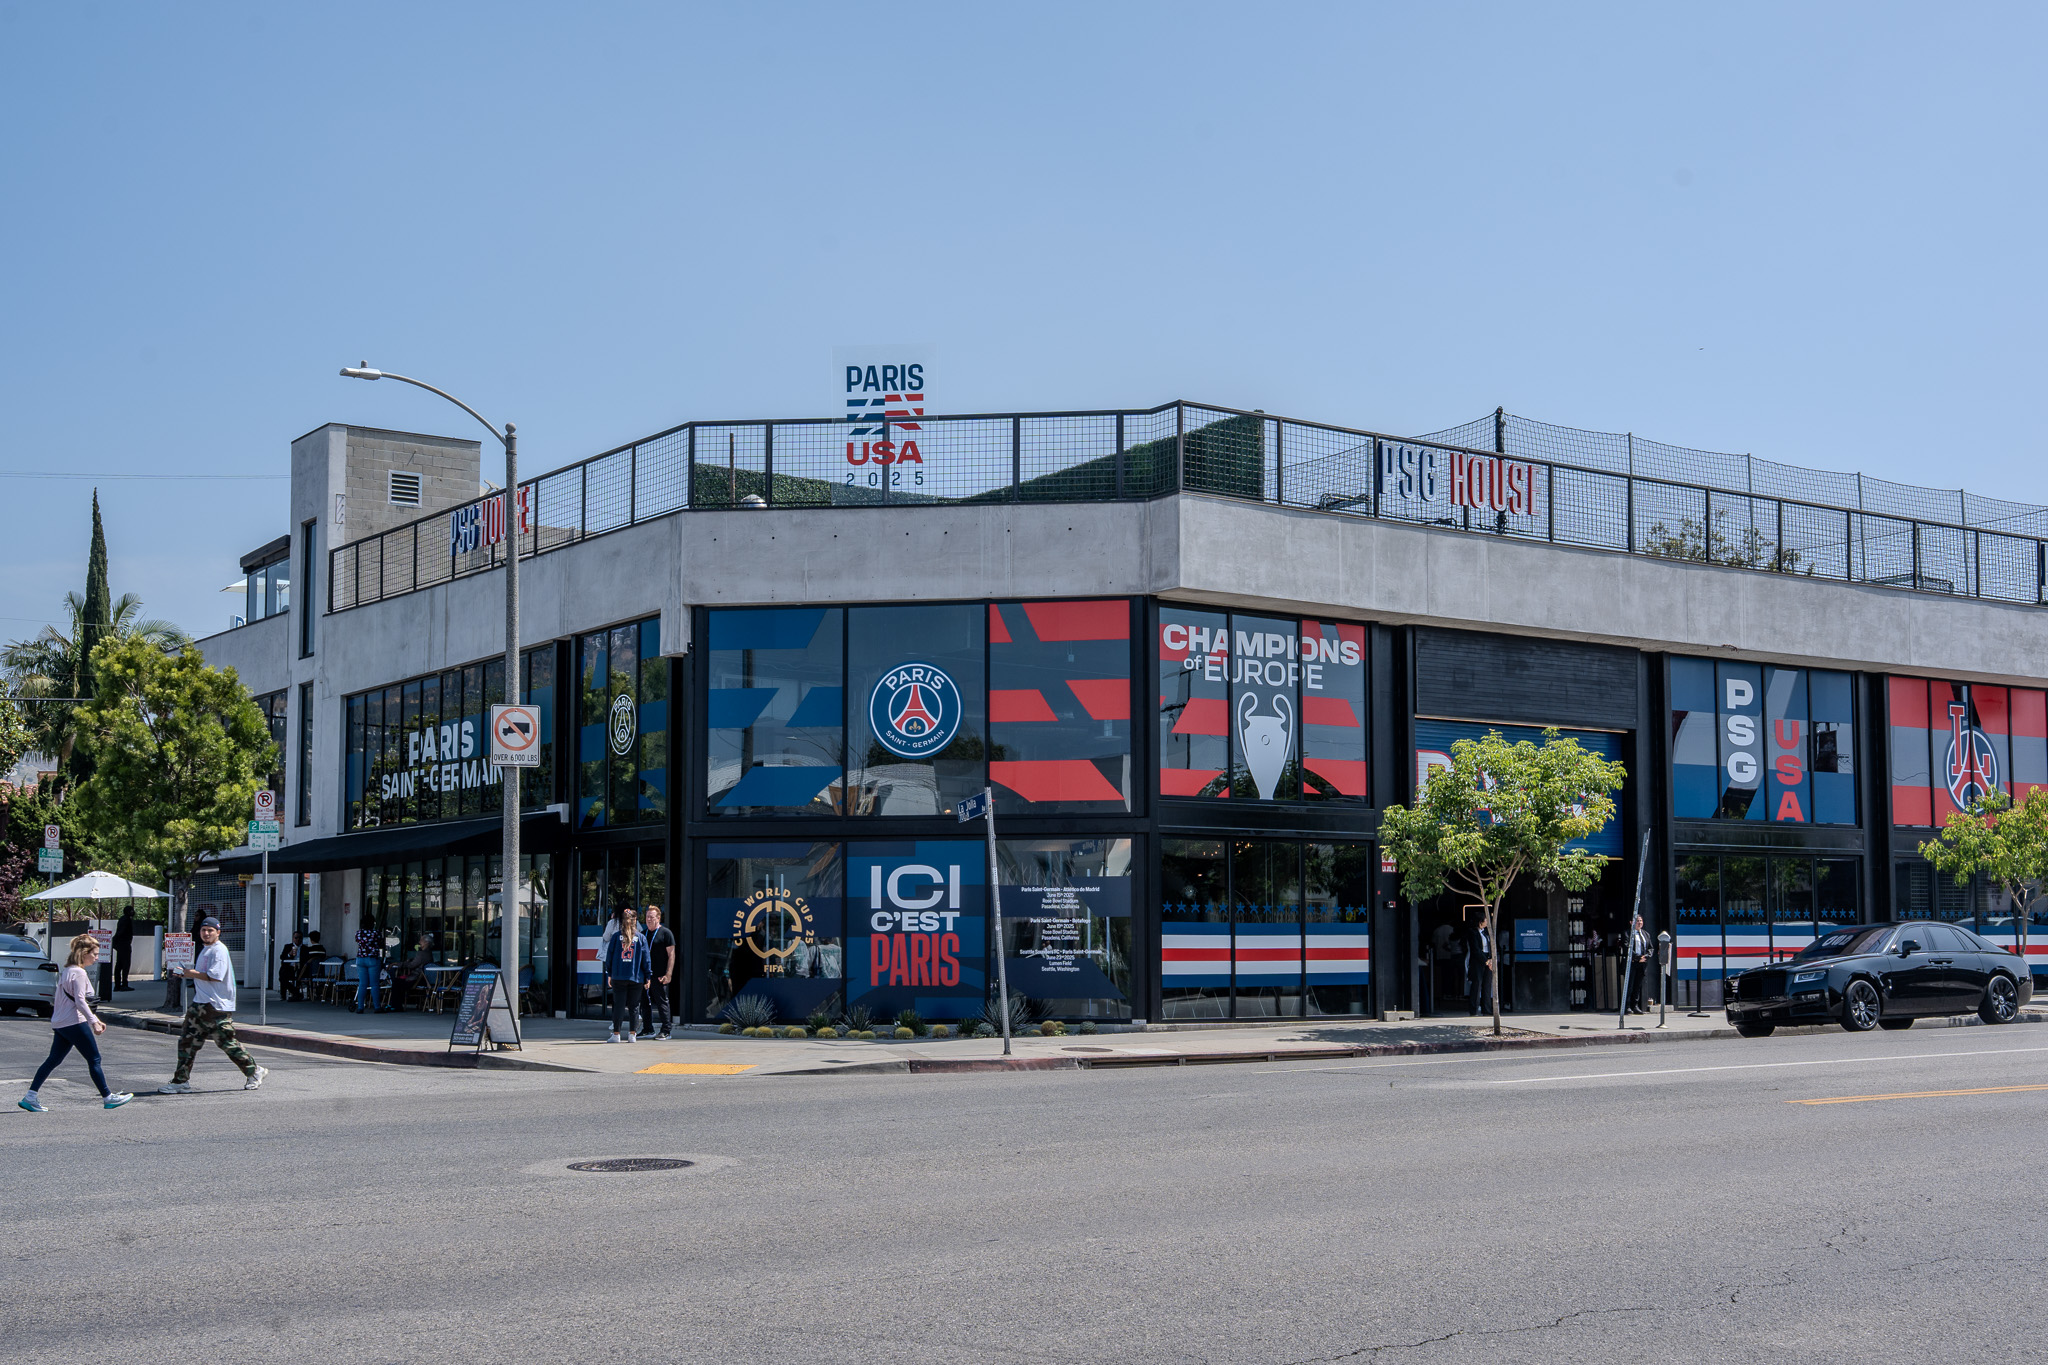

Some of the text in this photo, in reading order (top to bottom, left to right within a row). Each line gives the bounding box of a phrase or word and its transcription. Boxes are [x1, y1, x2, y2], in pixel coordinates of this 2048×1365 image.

[846, 363, 924, 392] PARIS
[846, 440, 924, 466] USA
[846, 471, 924, 487] 2025
[1379, 441, 1544, 517] PSG HOUSE
[450, 486, 530, 556] PSG HOUE
[1163, 623, 1361, 666] CHAMPIONS
[885, 668, 945, 690] PARIS
[1183, 654, 1324, 690] of EUROPE
[614, 697, 631, 713] PARIS
[408, 720, 474, 767] PARIS
[886, 730, 907, 747] SAINT
[912, 729, 945, 748] GERMAIN
[251, 821, 258, 830] 2
[871, 864, 960, 909] ICI
[733, 887, 815, 946] CLUB WORLD CUP 25
[871, 911, 960, 932] C'EST
[763, 964, 785, 972] FIFA
[871, 933, 960, 987] PARIS
